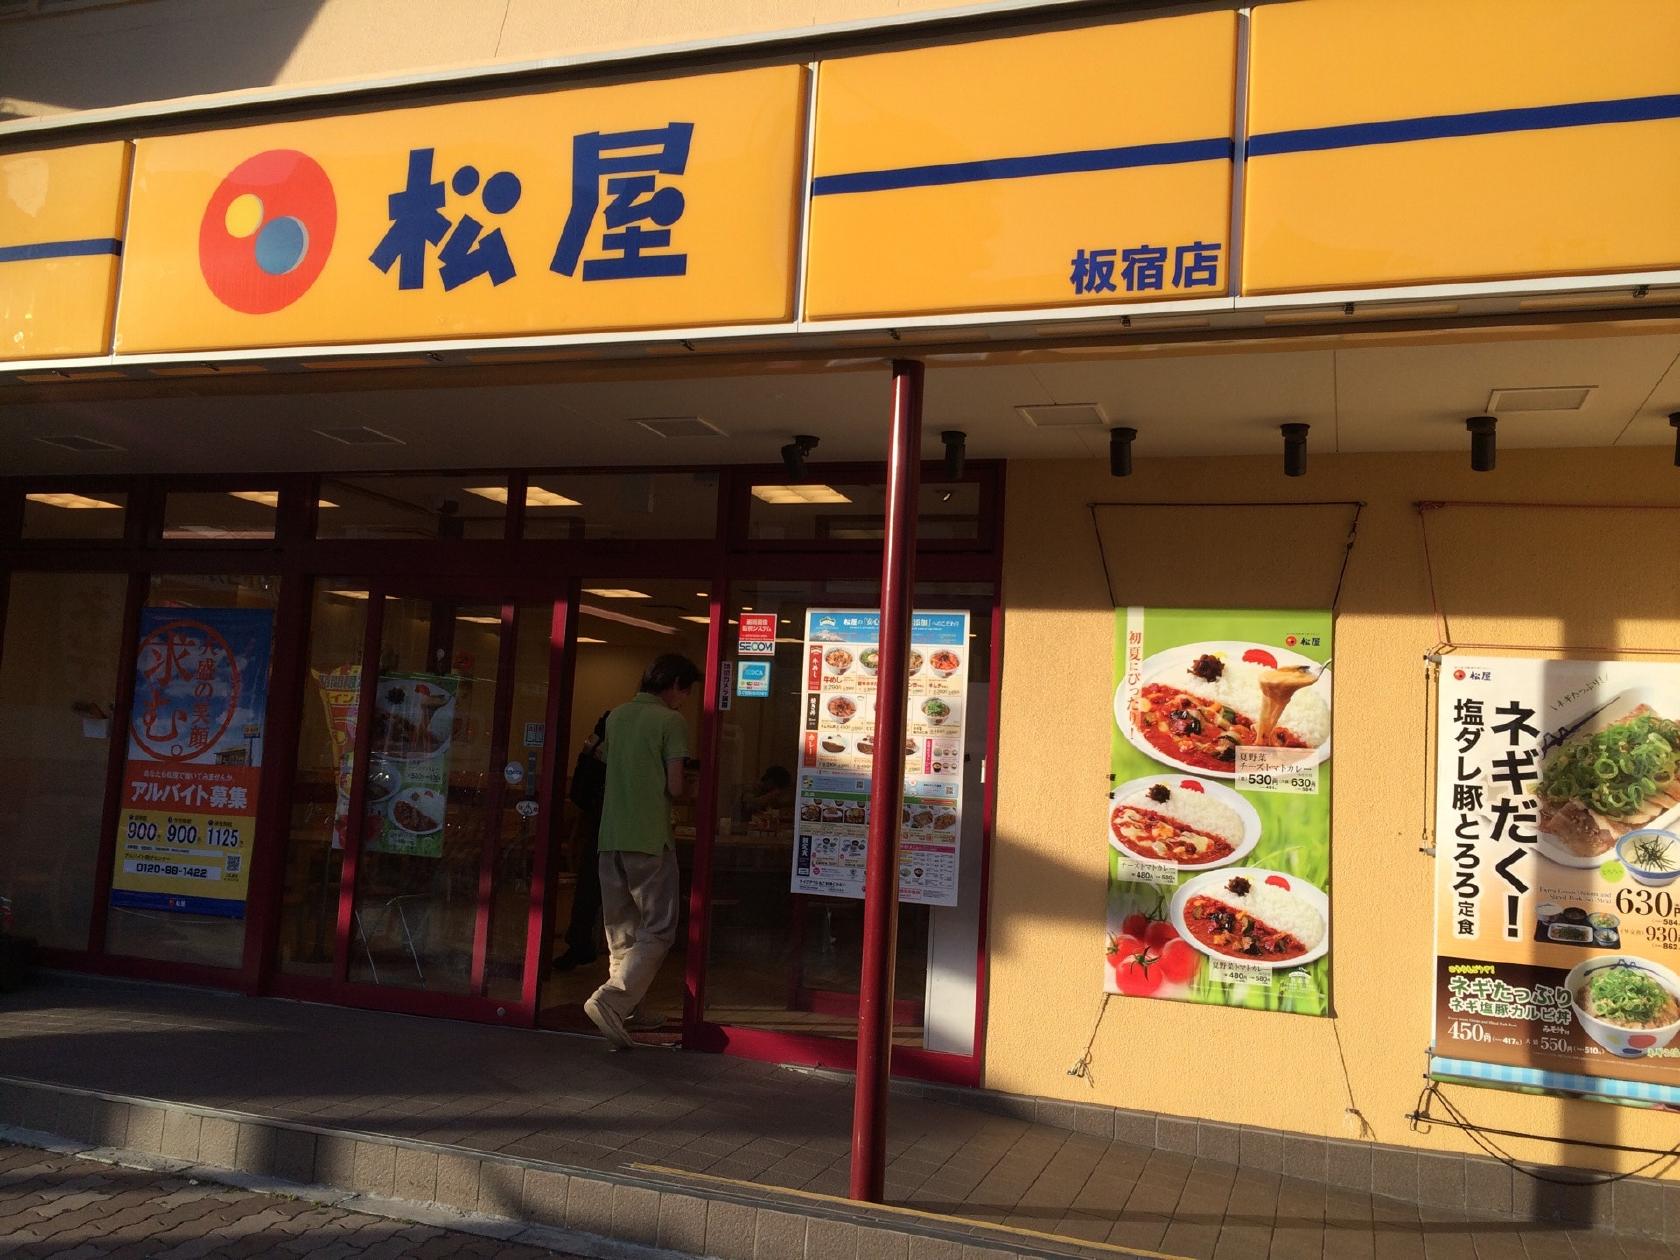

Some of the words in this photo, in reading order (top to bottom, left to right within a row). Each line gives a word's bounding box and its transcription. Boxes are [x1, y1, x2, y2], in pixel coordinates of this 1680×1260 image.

[369, 122, 695, 292] 松屋
[1069, 241, 1222, 295] 板宿店
[739, 642, 773, 652] SECOM
[1300, 637, 1320, 646] 松屋
[1470, 671, 1491, 681] 松屋
[1240, 762, 1313, 773] チーズトマトカレー
[130, 780, 248, 808] アルバイト募集
[1452, 698, 1485, 936] 塩ダレ豚とろろ定食
[1489, 700, 1541, 938] ネギだく!
[1448, 975, 1574, 1008] ネギたっぷり
[1448, 997, 1572, 1026] ネギ塩豚カルビ丼
[1448, 1021, 1492, 1044] 450円
[1540, 1036, 1573, 1053] 550円
